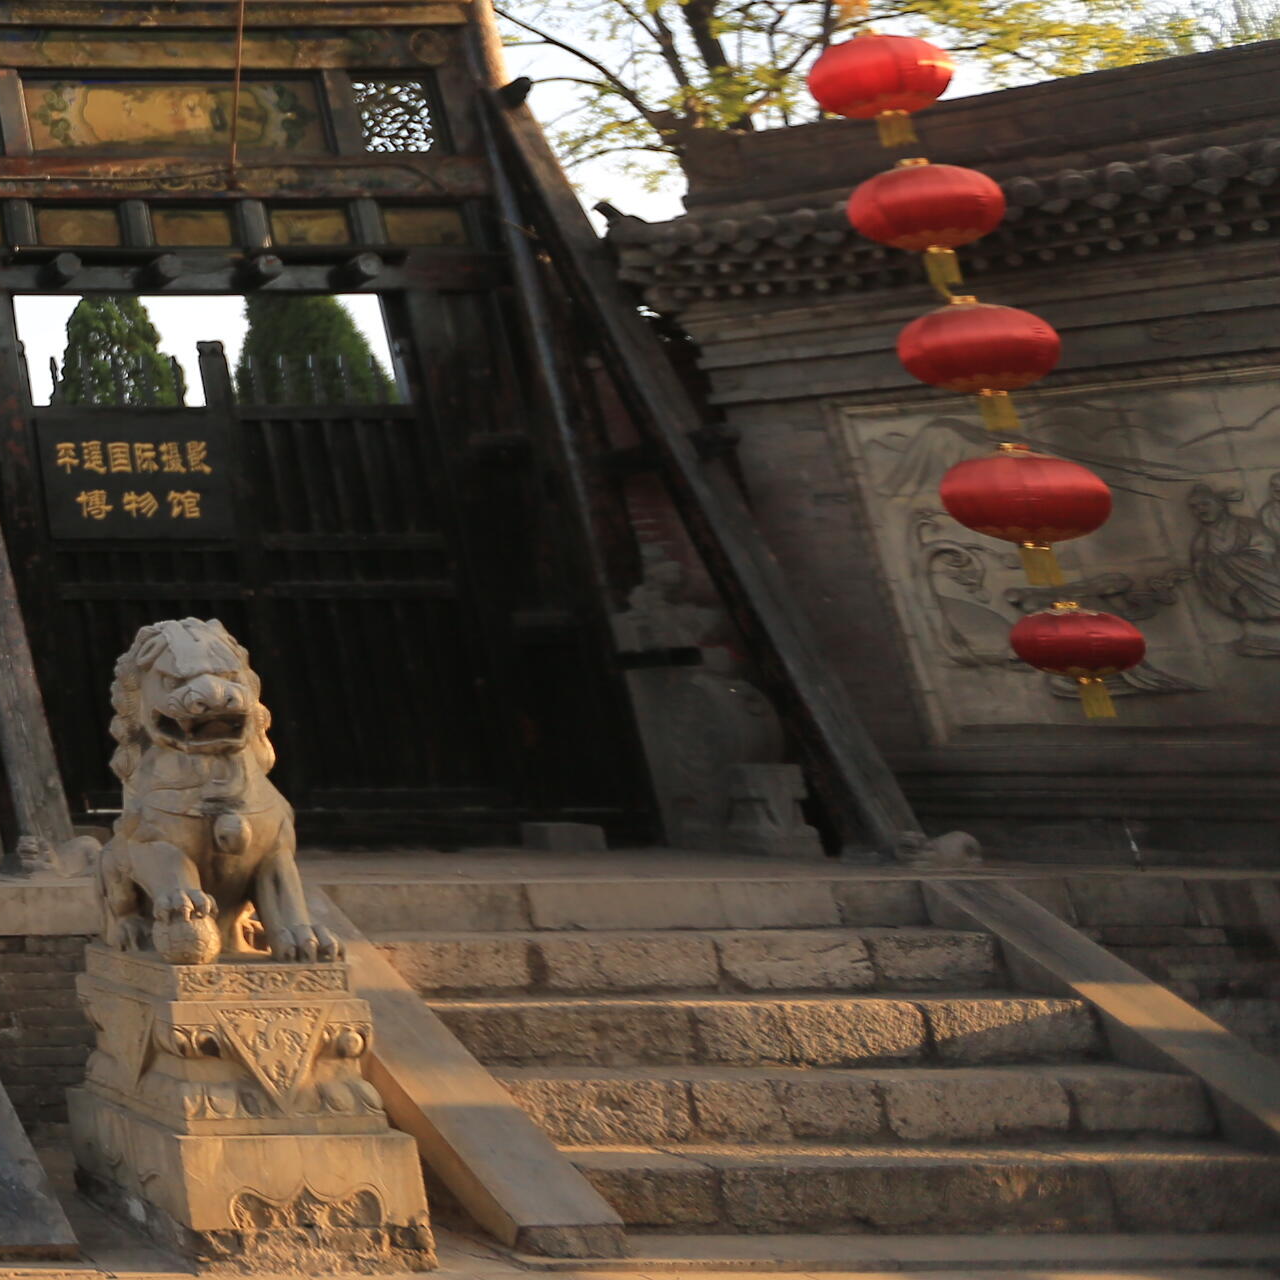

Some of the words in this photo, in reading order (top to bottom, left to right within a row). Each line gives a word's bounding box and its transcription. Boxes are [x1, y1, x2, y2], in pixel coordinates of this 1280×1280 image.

[56, 440, 213, 475] 平遥国际摄影
[75, 489, 202, 519] 博物馆
